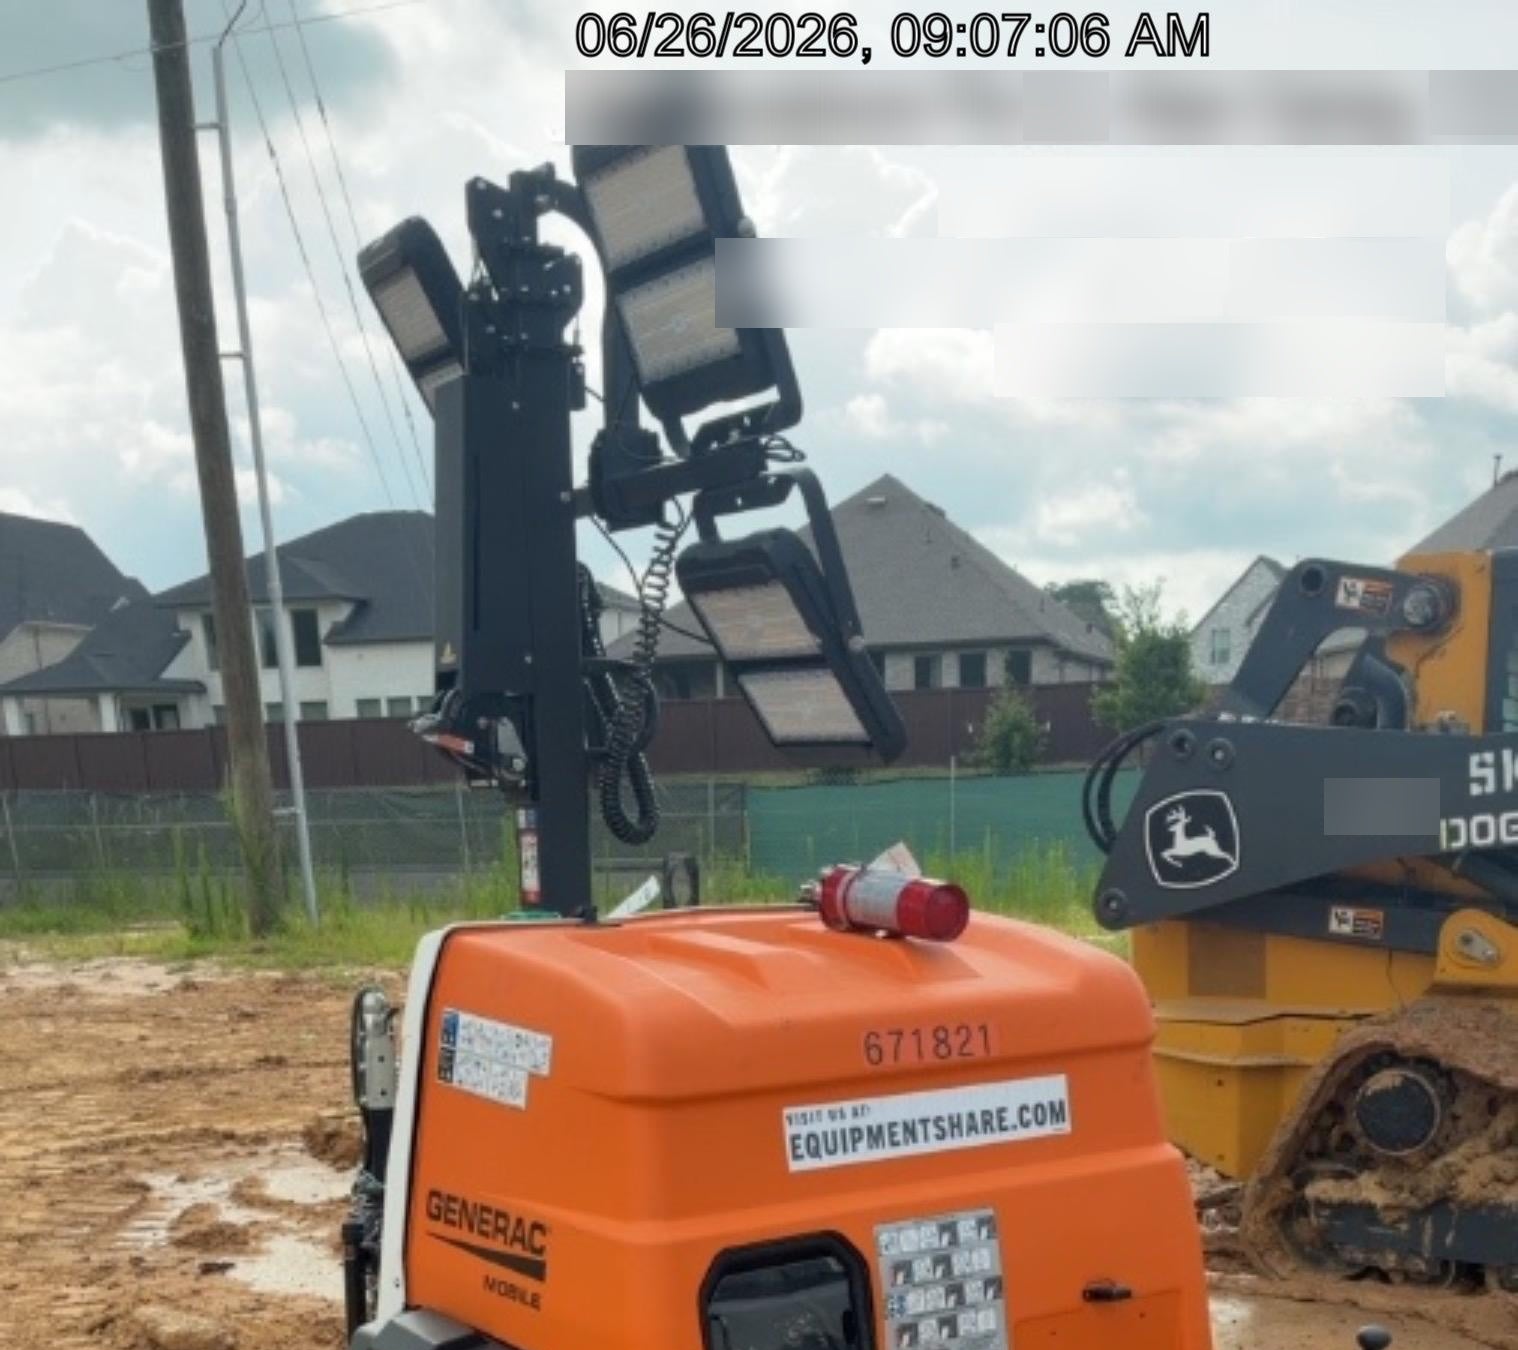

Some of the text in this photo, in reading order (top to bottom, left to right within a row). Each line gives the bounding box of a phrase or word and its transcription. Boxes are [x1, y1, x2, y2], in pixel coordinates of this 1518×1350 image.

[864, 1024, 993, 1066] 671821
[785, 1111, 823, 1127] VISIT
[789, 1097, 1067, 1162] EQUIPMENTSHARE.COM
[426, 1189, 547, 1257] GENERAC
[482, 1273, 542, 1313] MOBILE
